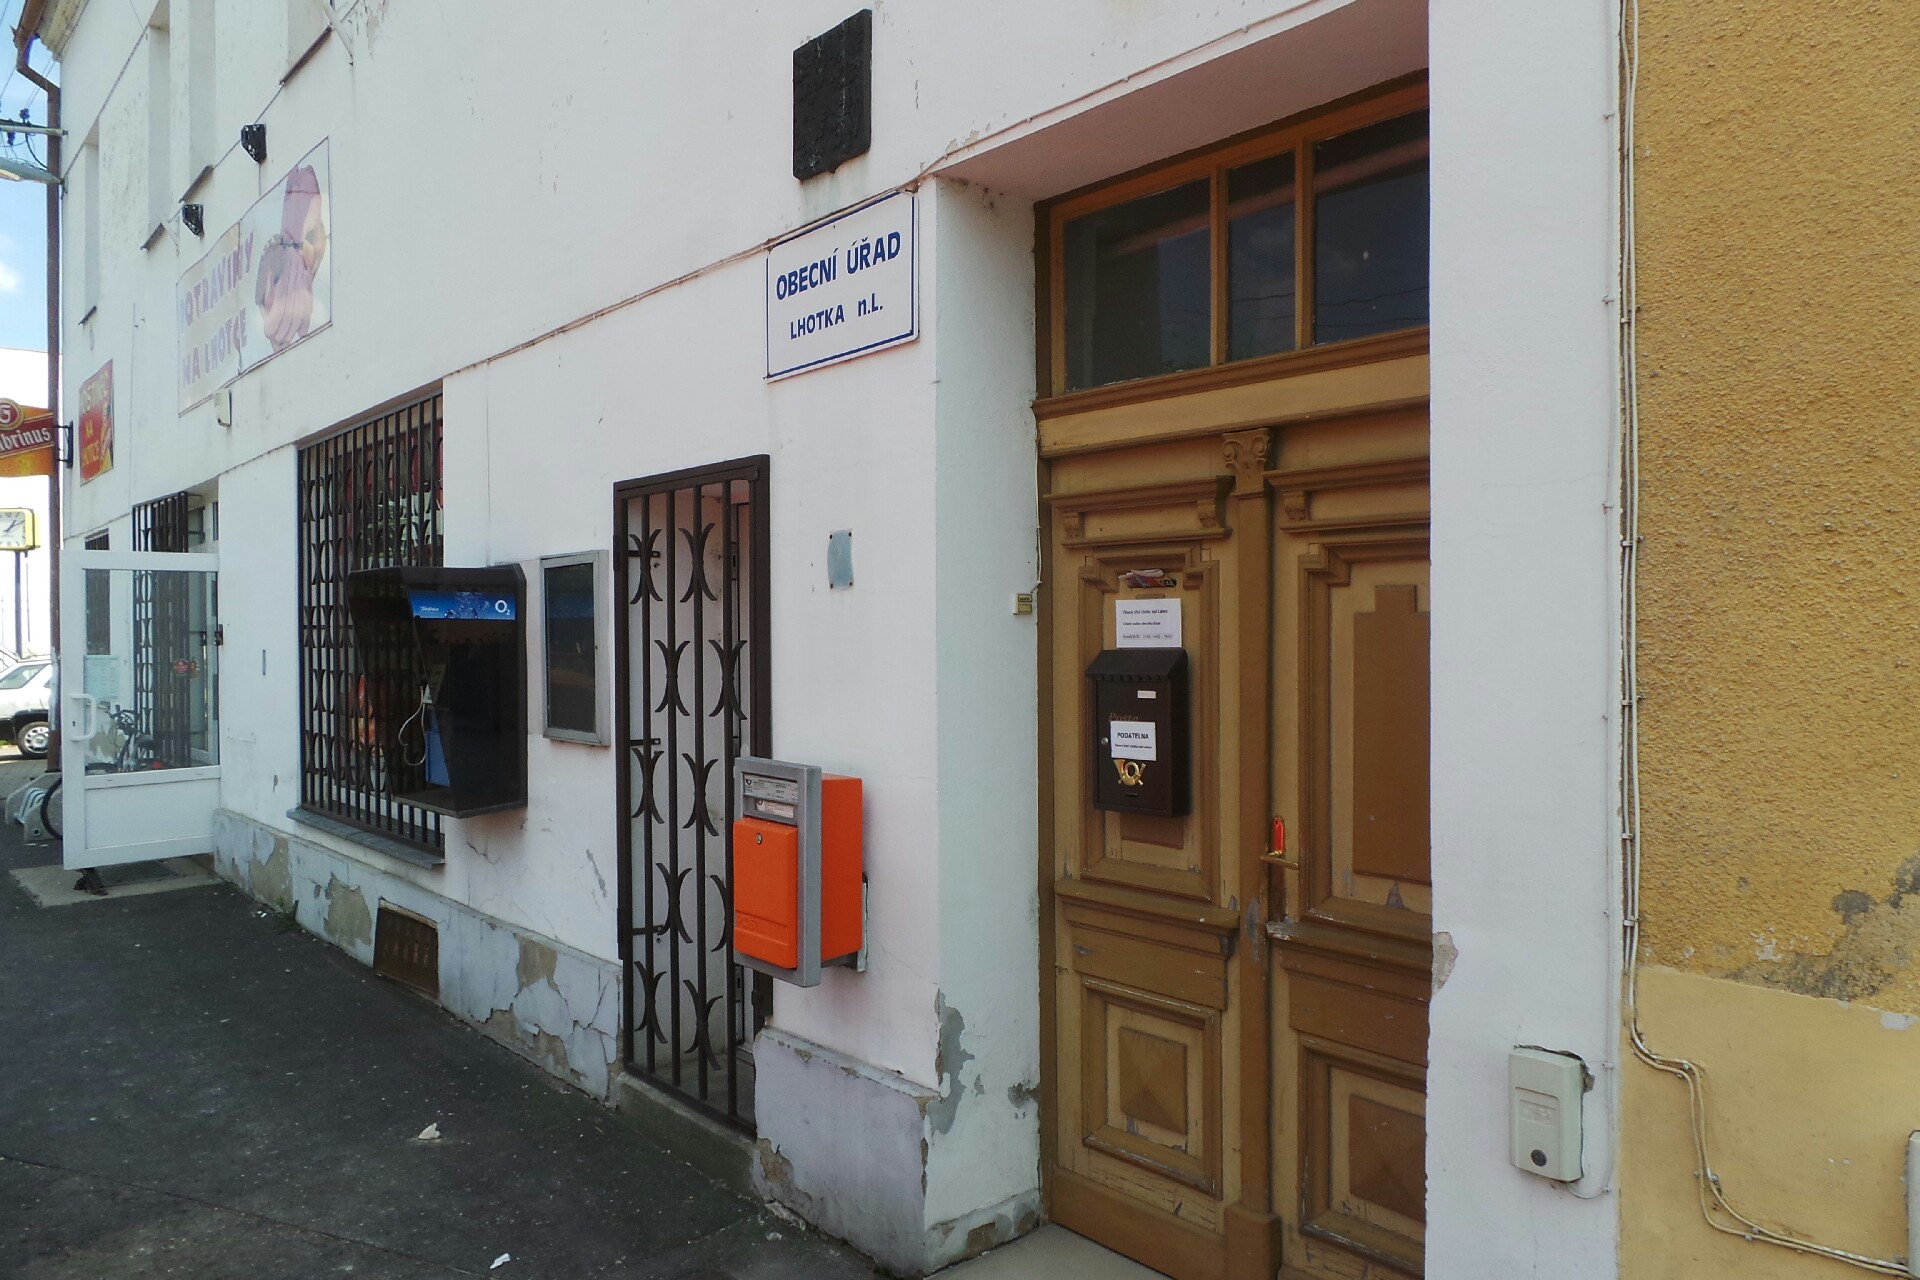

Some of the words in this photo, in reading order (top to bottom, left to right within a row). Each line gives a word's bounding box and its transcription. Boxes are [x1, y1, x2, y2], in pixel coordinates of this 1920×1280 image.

[180, 230, 254, 333] POTRAVINY
[776, 247, 839, 300] OBECNÍ
[846, 231, 901, 275] ÚŘAD
[790, 304, 845, 340] LHOTKA
[857, 292, 883, 317] n.L.
[183, 347, 200, 388] NA
[205, 307, 248, 374] LHOTCE
[0, 427, 51, 451] brinus
[494, 599, 511, 616] O2
[1117, 732, 1149, 740] PODATELNA
